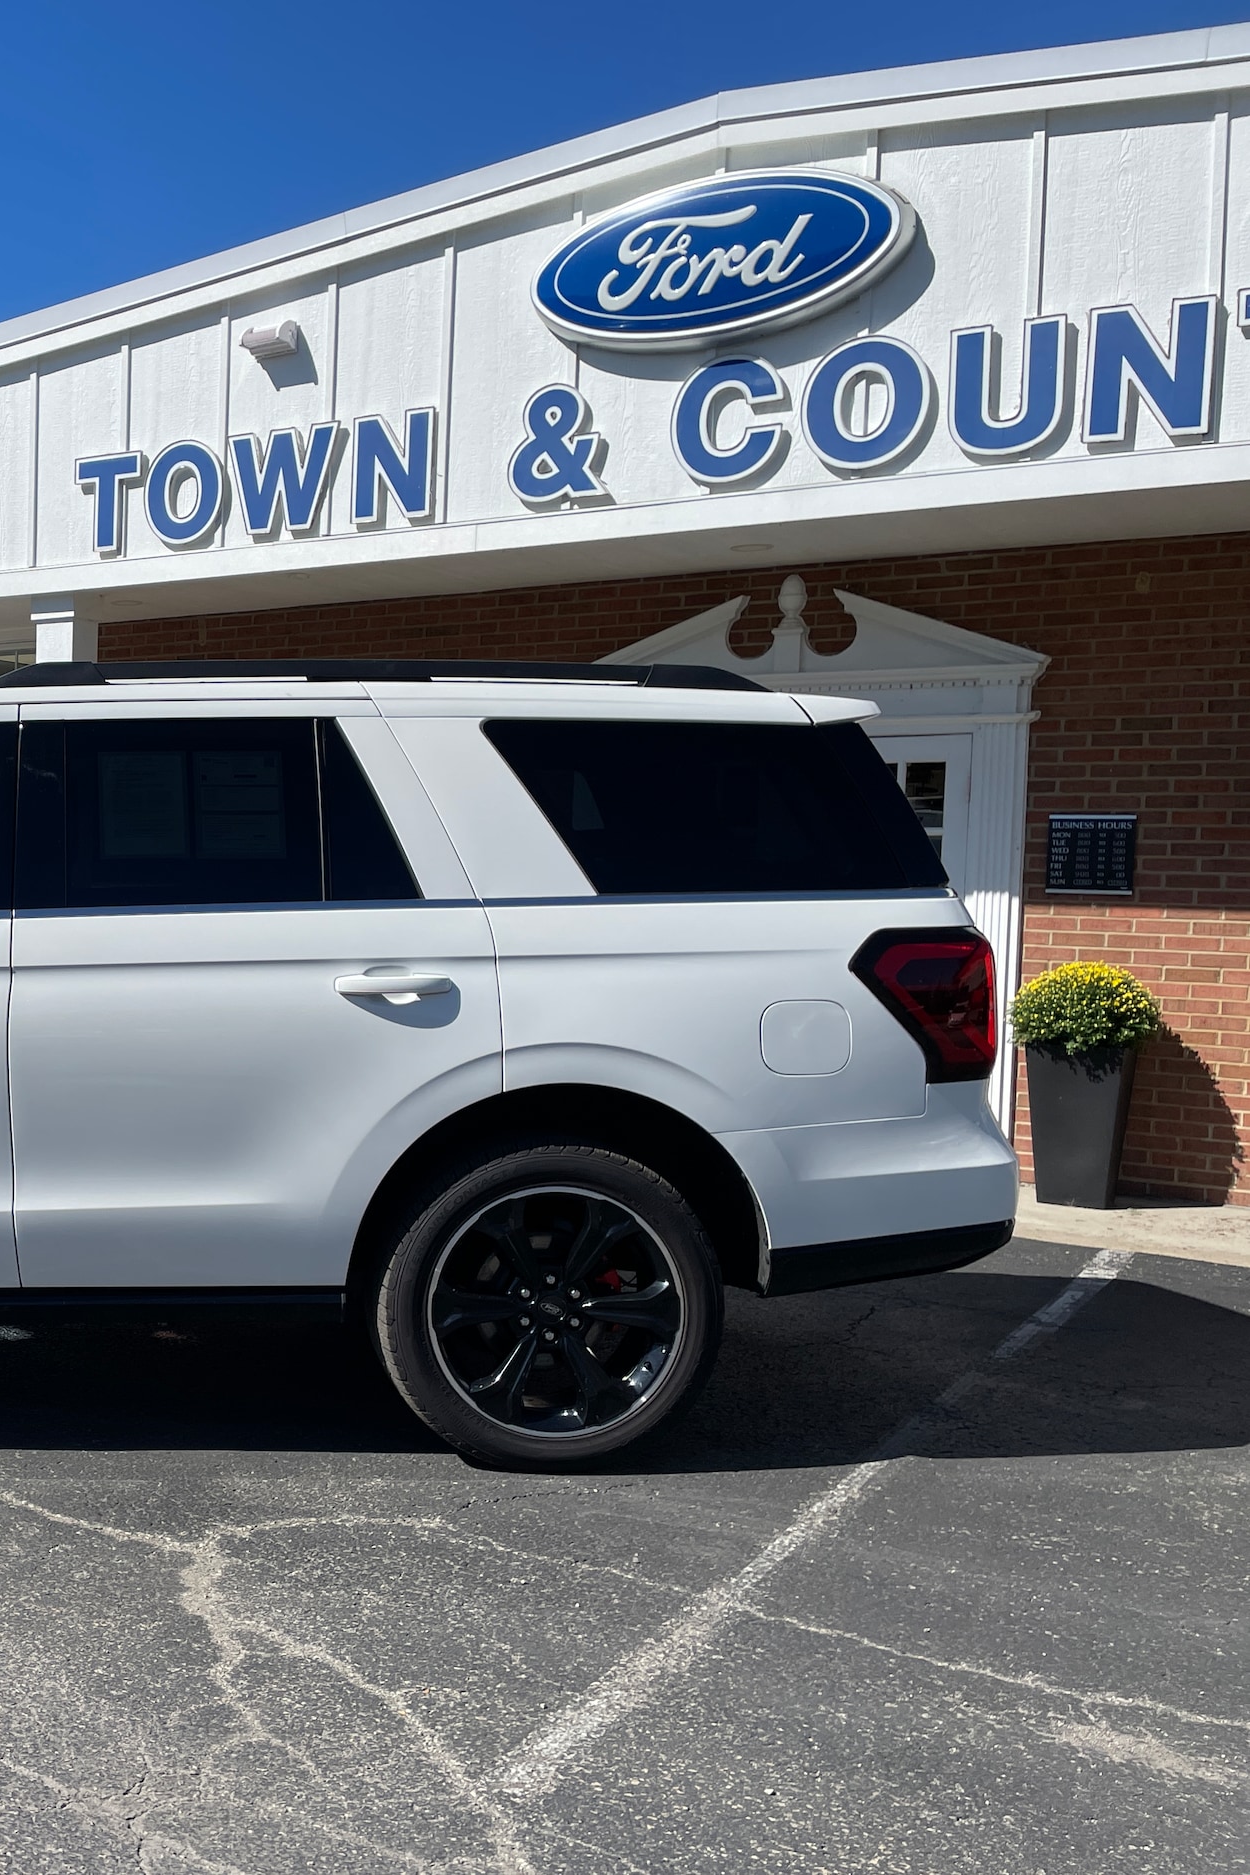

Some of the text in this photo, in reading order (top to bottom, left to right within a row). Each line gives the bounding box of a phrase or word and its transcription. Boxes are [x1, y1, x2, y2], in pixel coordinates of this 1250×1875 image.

[598, 203, 814, 311] Ford
[75, 286, 1250, 553] TOWN & COUN
[1052, 821, 1133, 829] BUSINESS HOURS
